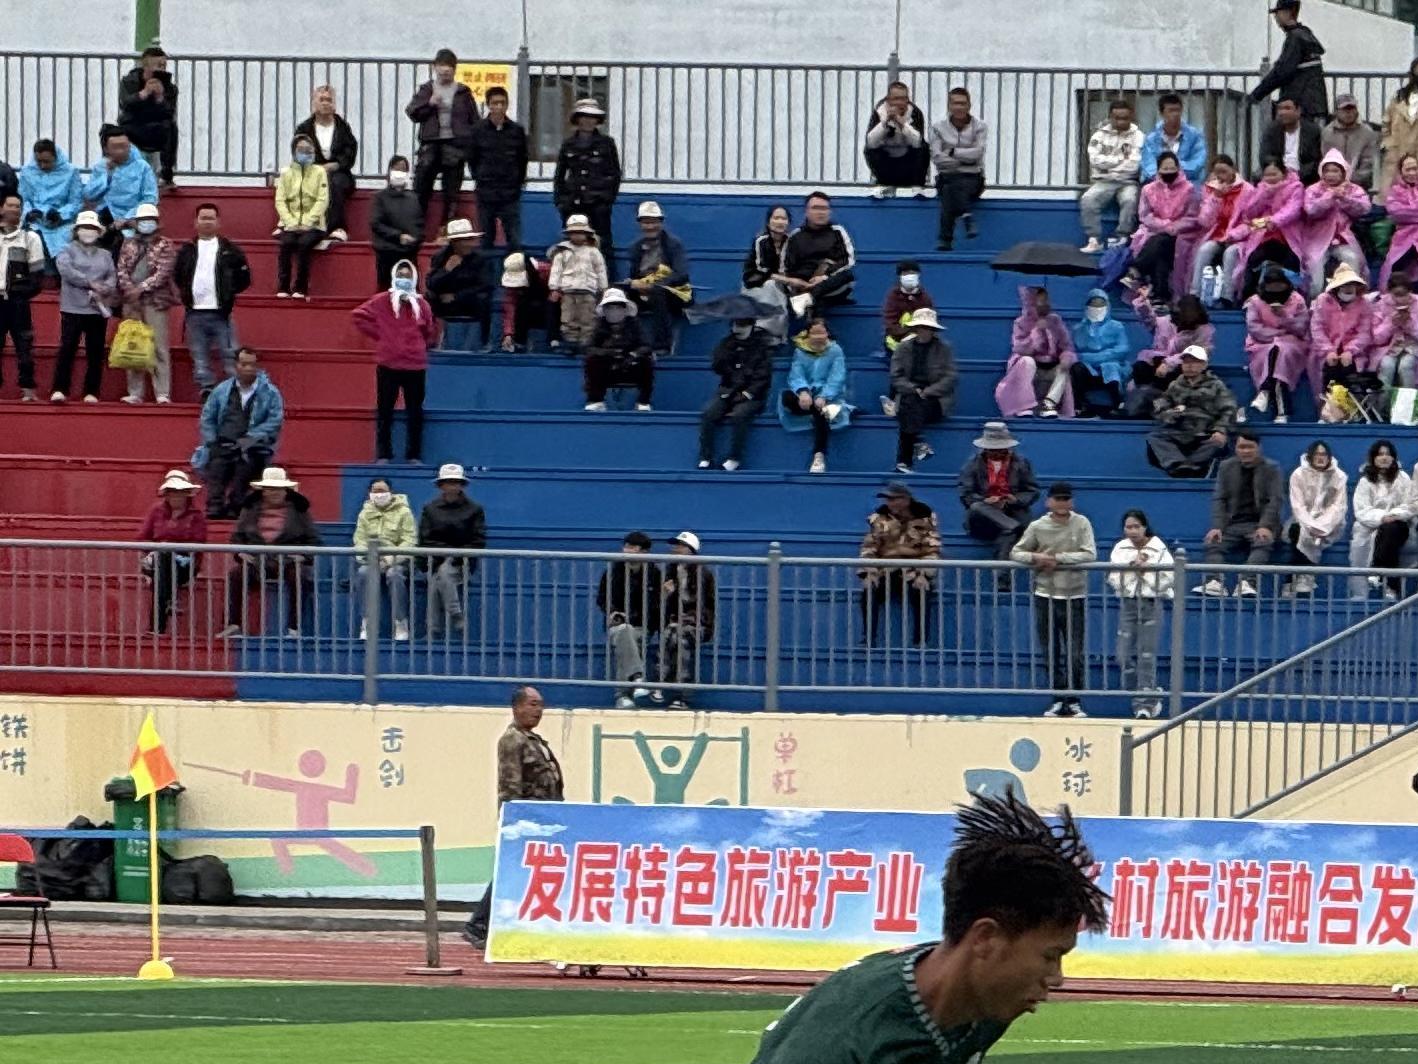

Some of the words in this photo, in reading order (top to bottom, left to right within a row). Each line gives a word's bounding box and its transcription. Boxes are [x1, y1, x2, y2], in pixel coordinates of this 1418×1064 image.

[1063, 737, 1093, 798] 冰球
[518, 841, 924, 934] 发展特色旅游产业
